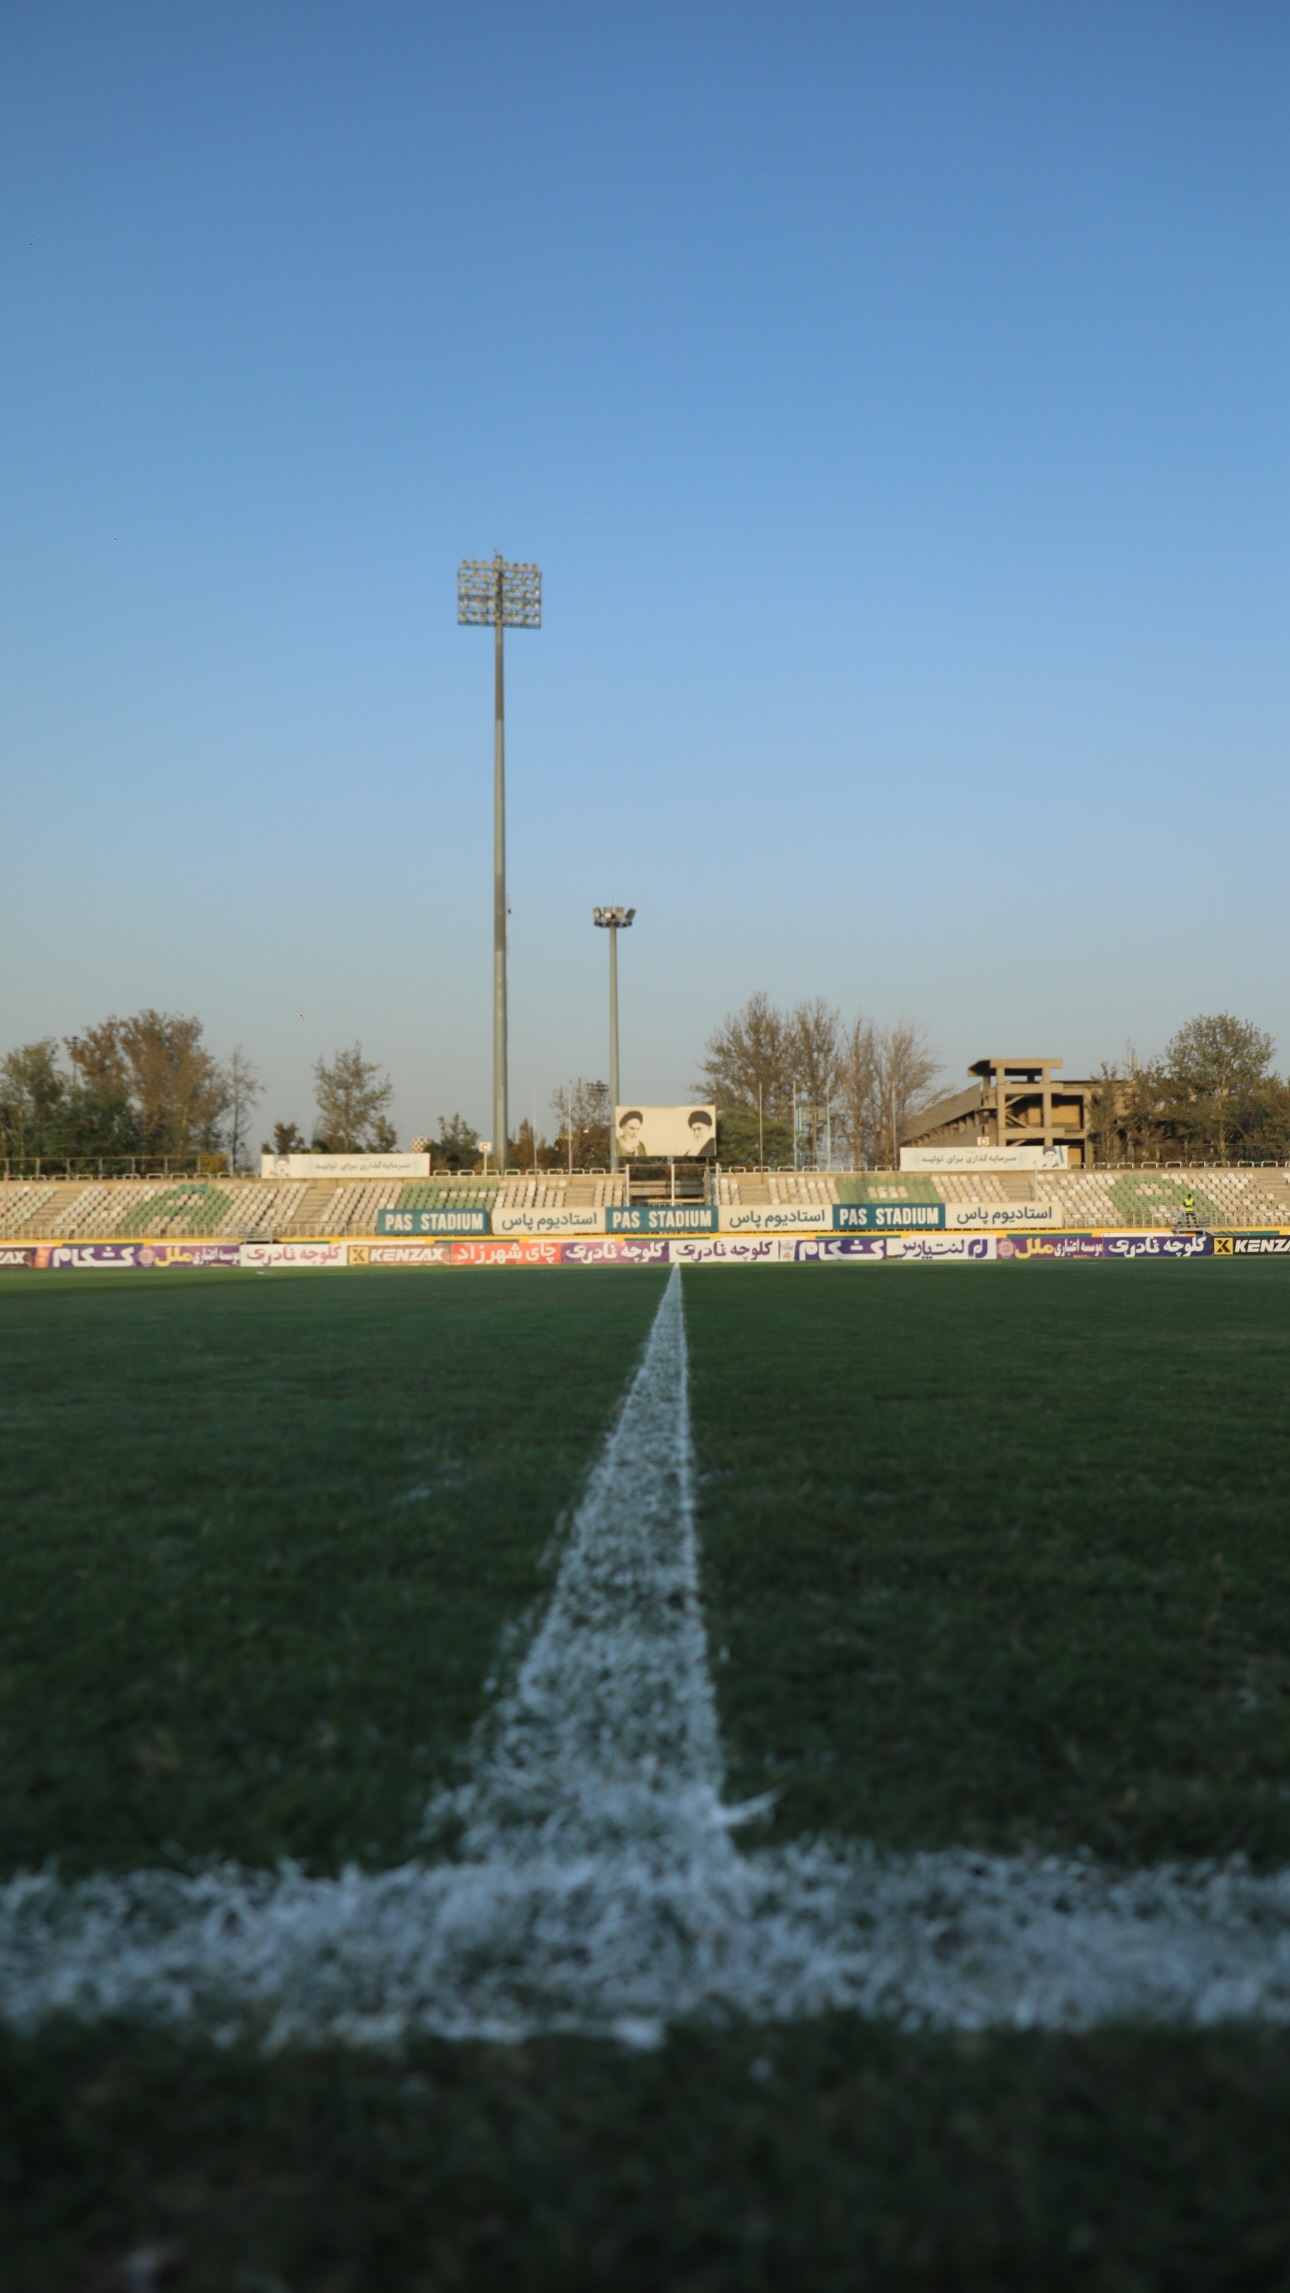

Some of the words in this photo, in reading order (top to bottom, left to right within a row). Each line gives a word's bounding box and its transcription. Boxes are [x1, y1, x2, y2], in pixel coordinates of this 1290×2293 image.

[921, 1154, 944, 1163] تولید
[946, 1154, 963, 1164] برای
[385, 1213, 412, 1231] PAS
[421, 1213, 484, 1231] STADIUM
[502, 1213, 533, 1231] پاس
[537, 1212, 597, 1231] استادیوم
[612, 1211, 640, 1229] PAS
[649, 1210, 712, 1228] STADIUM
[729, 1210, 761, 1228] پاس
[765, 1209, 825, 1227] استادیوم
[839, 1208, 867, 1225] PAS
[875, 1207, 939, 1225] STADIUM
[957, 1207, 988, 1225] پاس
[992, 1206, 1052, 1224] استادیوم
[246, 1245, 295, 1266] نادری
[300, 1245, 341, 1264] کلوچه
[370, 1248, 445, 1262] KENZAX
[457, 1243, 523, 1264] شهرزاد
[525, 1244, 557, 1264] چای
[566, 1242, 617, 1264] نادری
[620, 1241, 665, 1263] کلوچه
[676, 1241, 726, 1262] نادری
[730, 1241, 773, 1261] کلوچه
[1014, 1238, 1054, 1259] ملل
[1054, 1238, 1080, 1257] اعتباری
[1108, 1236, 1160, 1258] نادری
[1163, 1236, 1207, 1257] کلوچه
[1234, 1239, 1290, 1253] KENZ
[154, 1247, 193, 1267] ملل
